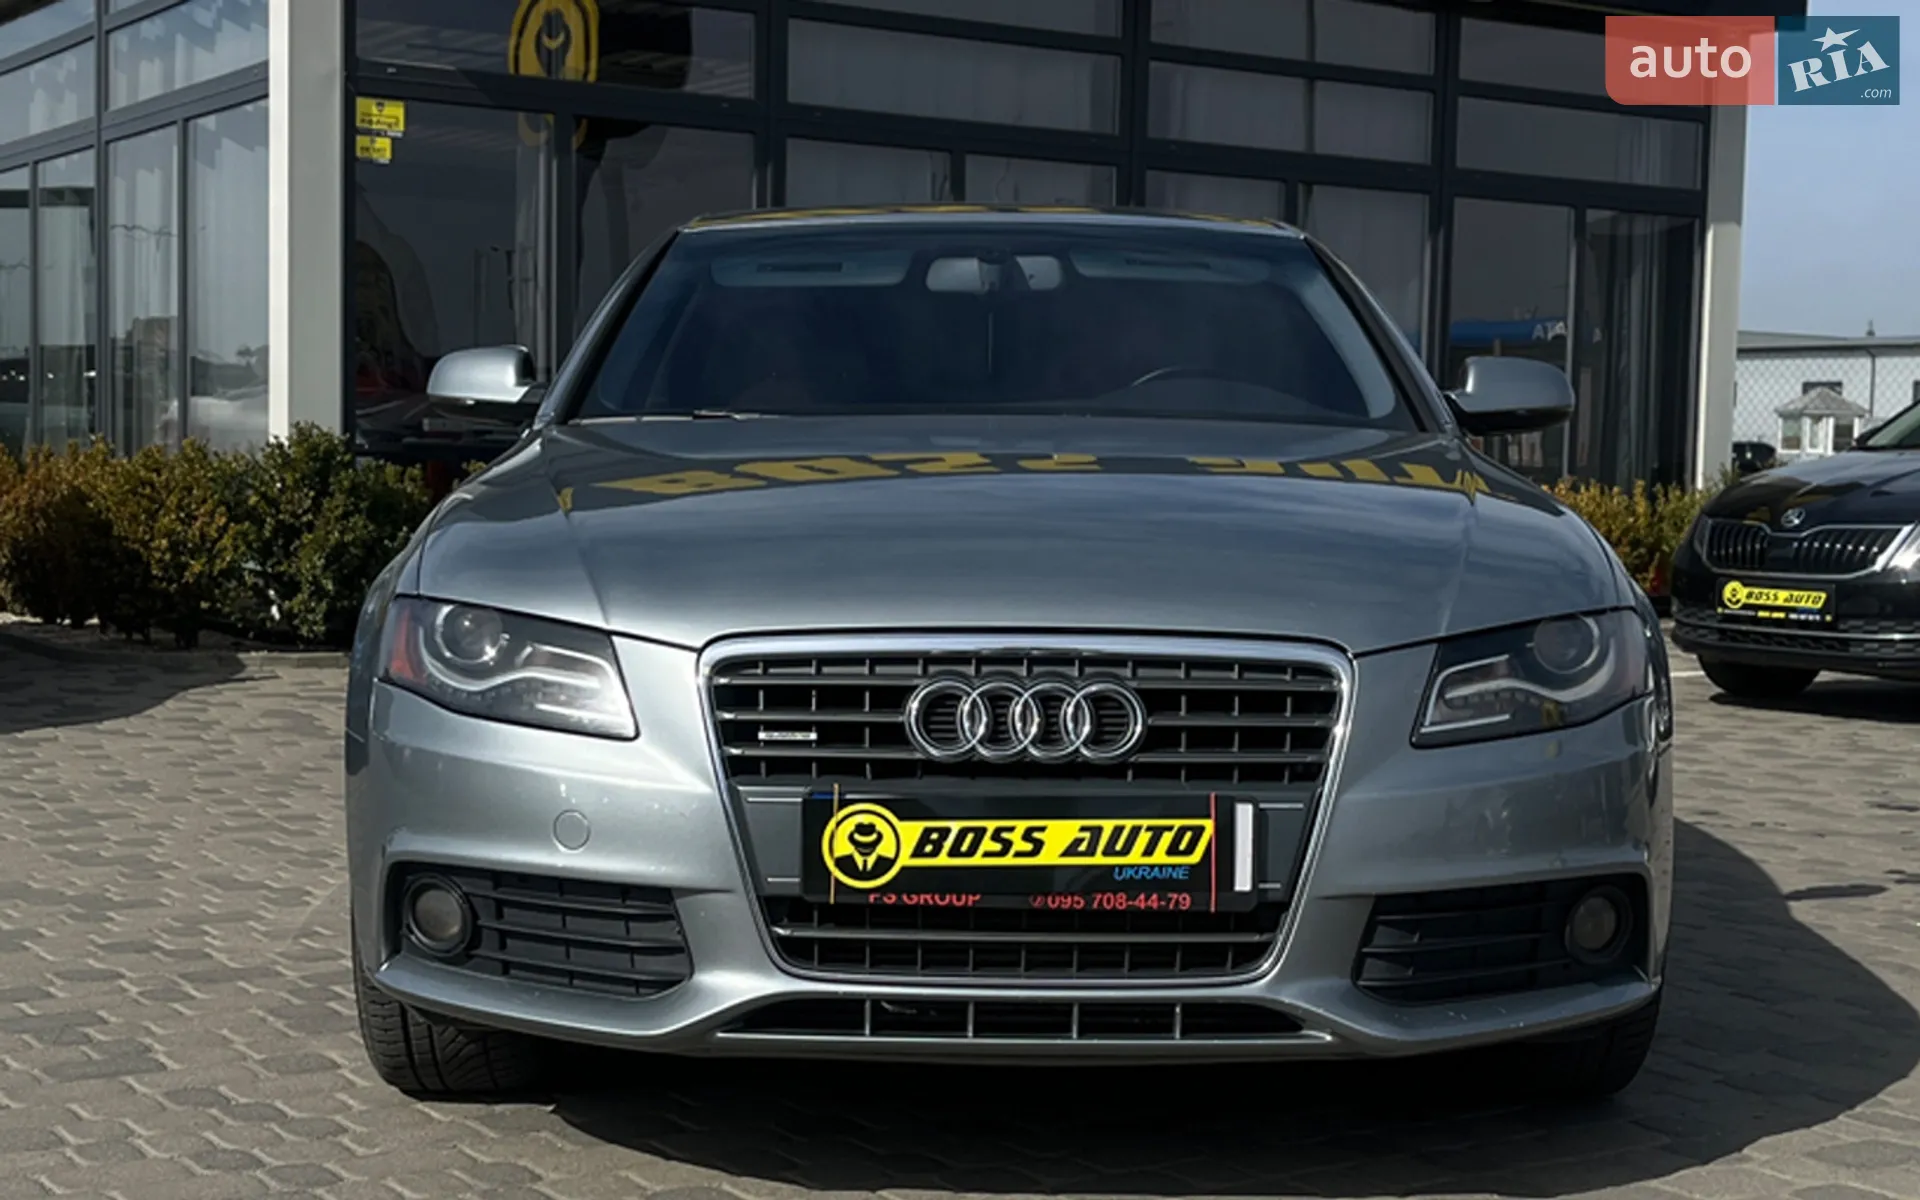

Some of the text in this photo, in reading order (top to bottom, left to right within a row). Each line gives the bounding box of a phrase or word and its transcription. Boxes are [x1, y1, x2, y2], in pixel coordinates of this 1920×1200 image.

[910, 823, 1207, 859] BOSS AUTO
[1113, 866, 1190, 881] UKRAINE
[1092, 893, 1191, 911] 708-44-79
